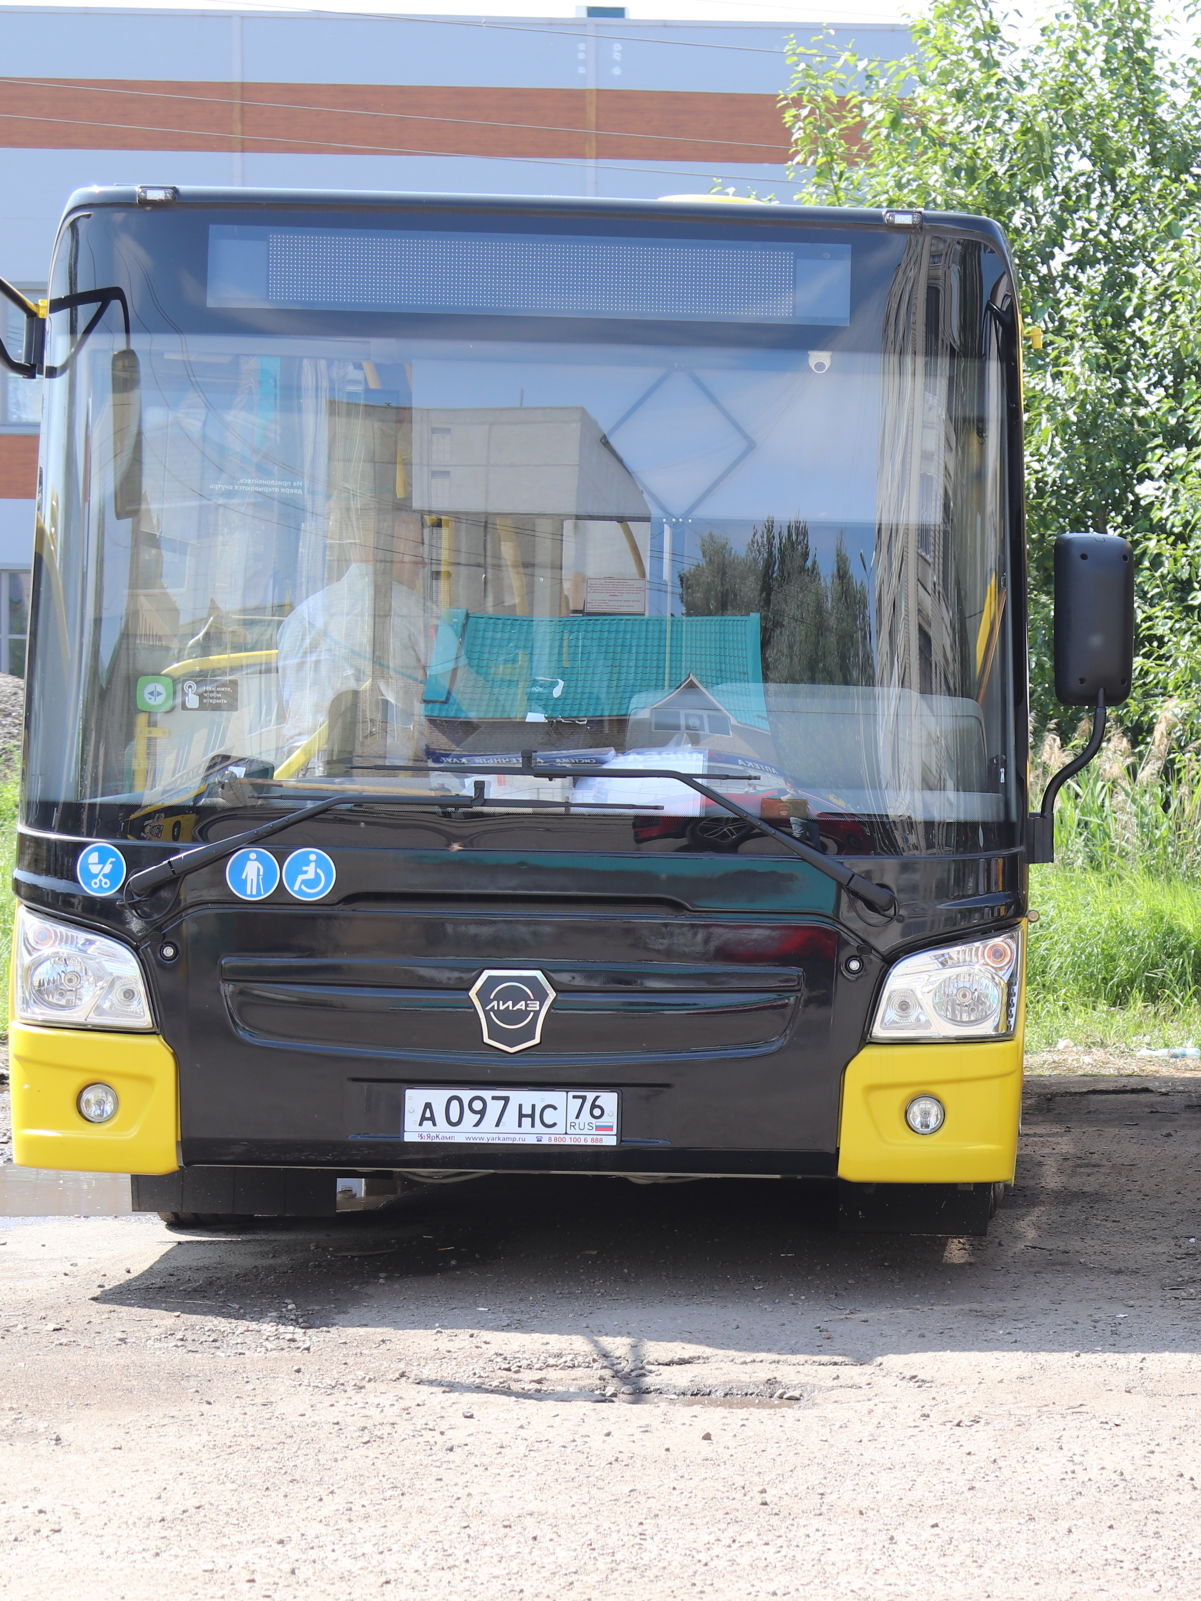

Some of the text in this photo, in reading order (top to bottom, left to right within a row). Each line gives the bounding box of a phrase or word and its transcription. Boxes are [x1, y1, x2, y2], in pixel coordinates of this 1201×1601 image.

[571, 1094, 606, 1120] 76
[569, 1121, 594, 1131] RUS
[426, 1133, 456, 1142] ЯрКамп
[464, 1135, 526, 1143] www.yarkamp.ru
